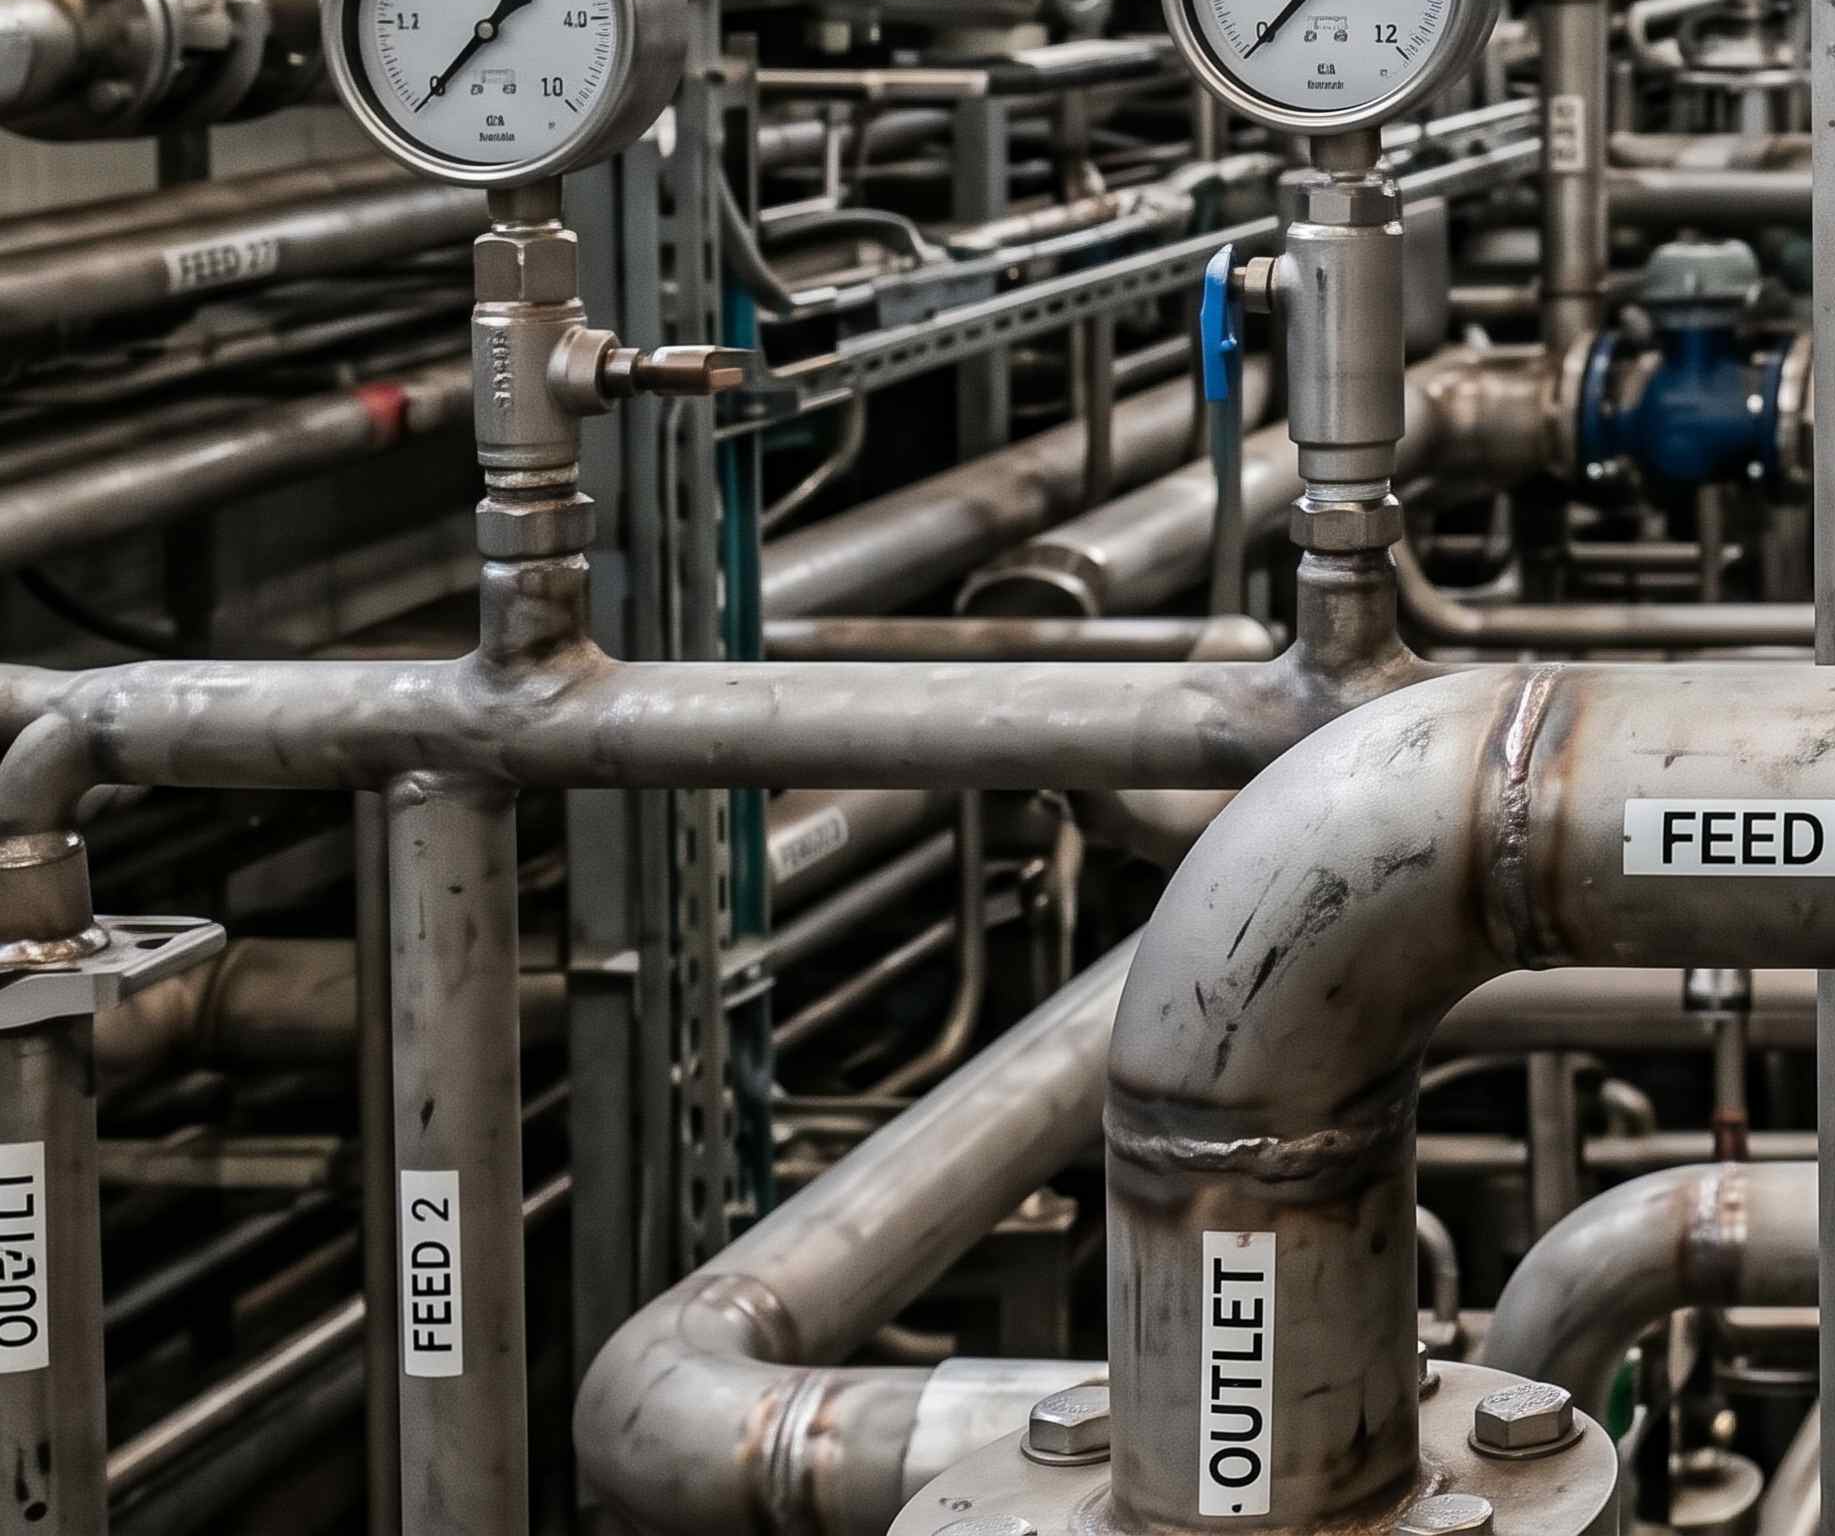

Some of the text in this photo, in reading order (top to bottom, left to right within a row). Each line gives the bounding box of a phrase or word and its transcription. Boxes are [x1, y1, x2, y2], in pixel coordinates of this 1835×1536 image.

[1374, 24, 1398, 44] 12
[1662, 811, 1825, 865] FEED
[411, 1197, 453, 1352] FEED 2
[1208, 1257, 1265, 1489] OUTLET
